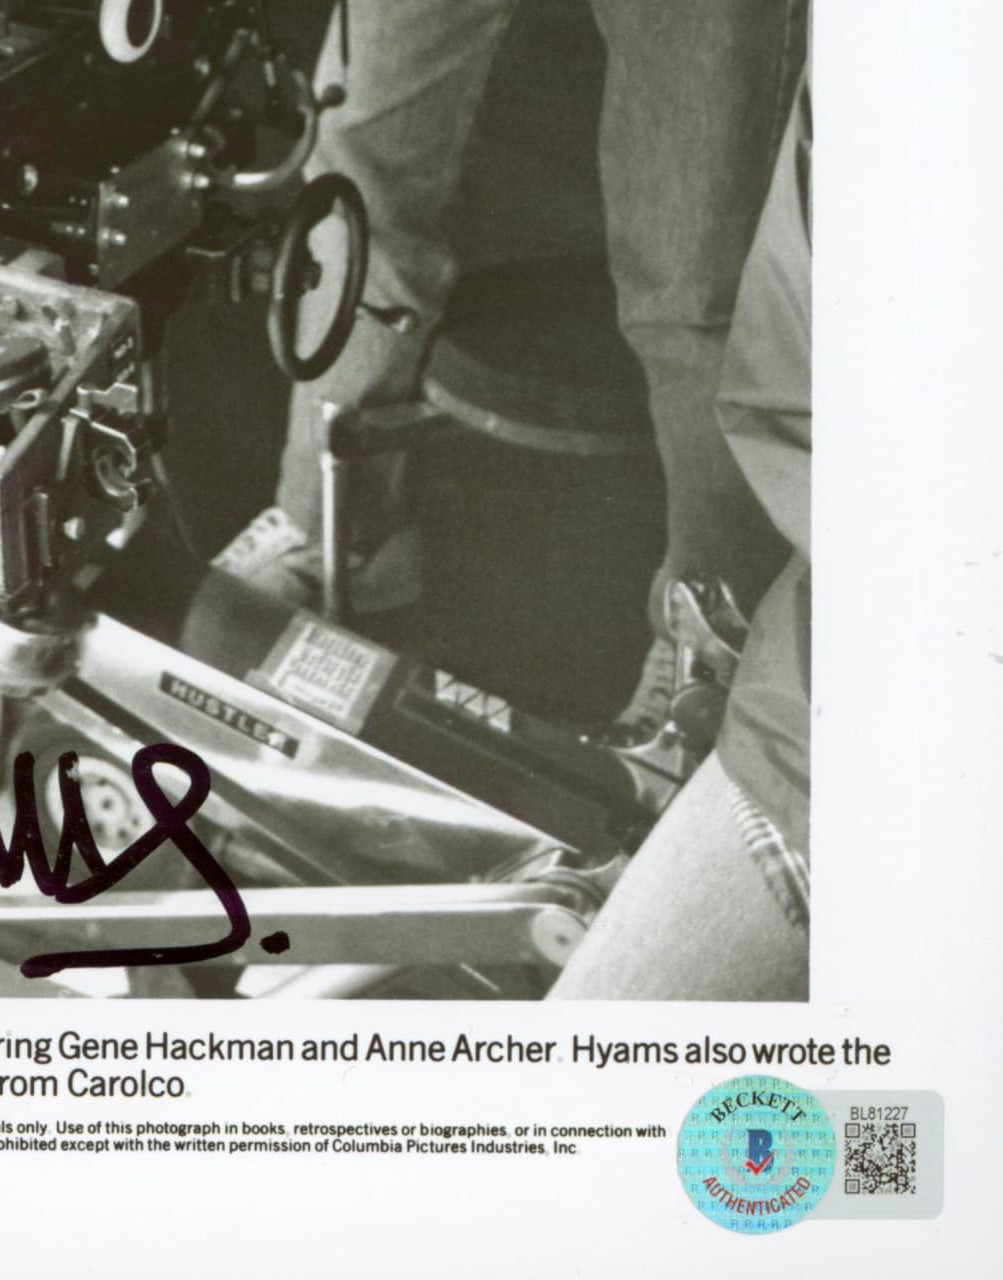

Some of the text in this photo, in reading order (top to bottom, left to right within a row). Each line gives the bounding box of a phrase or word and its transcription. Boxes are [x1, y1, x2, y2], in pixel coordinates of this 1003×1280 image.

[710, 1090, 807, 1123] BECKETT
[850, 1106, 909, 1120] BL81227
[702, 1176, 811, 1216] AUTHENTICATED
